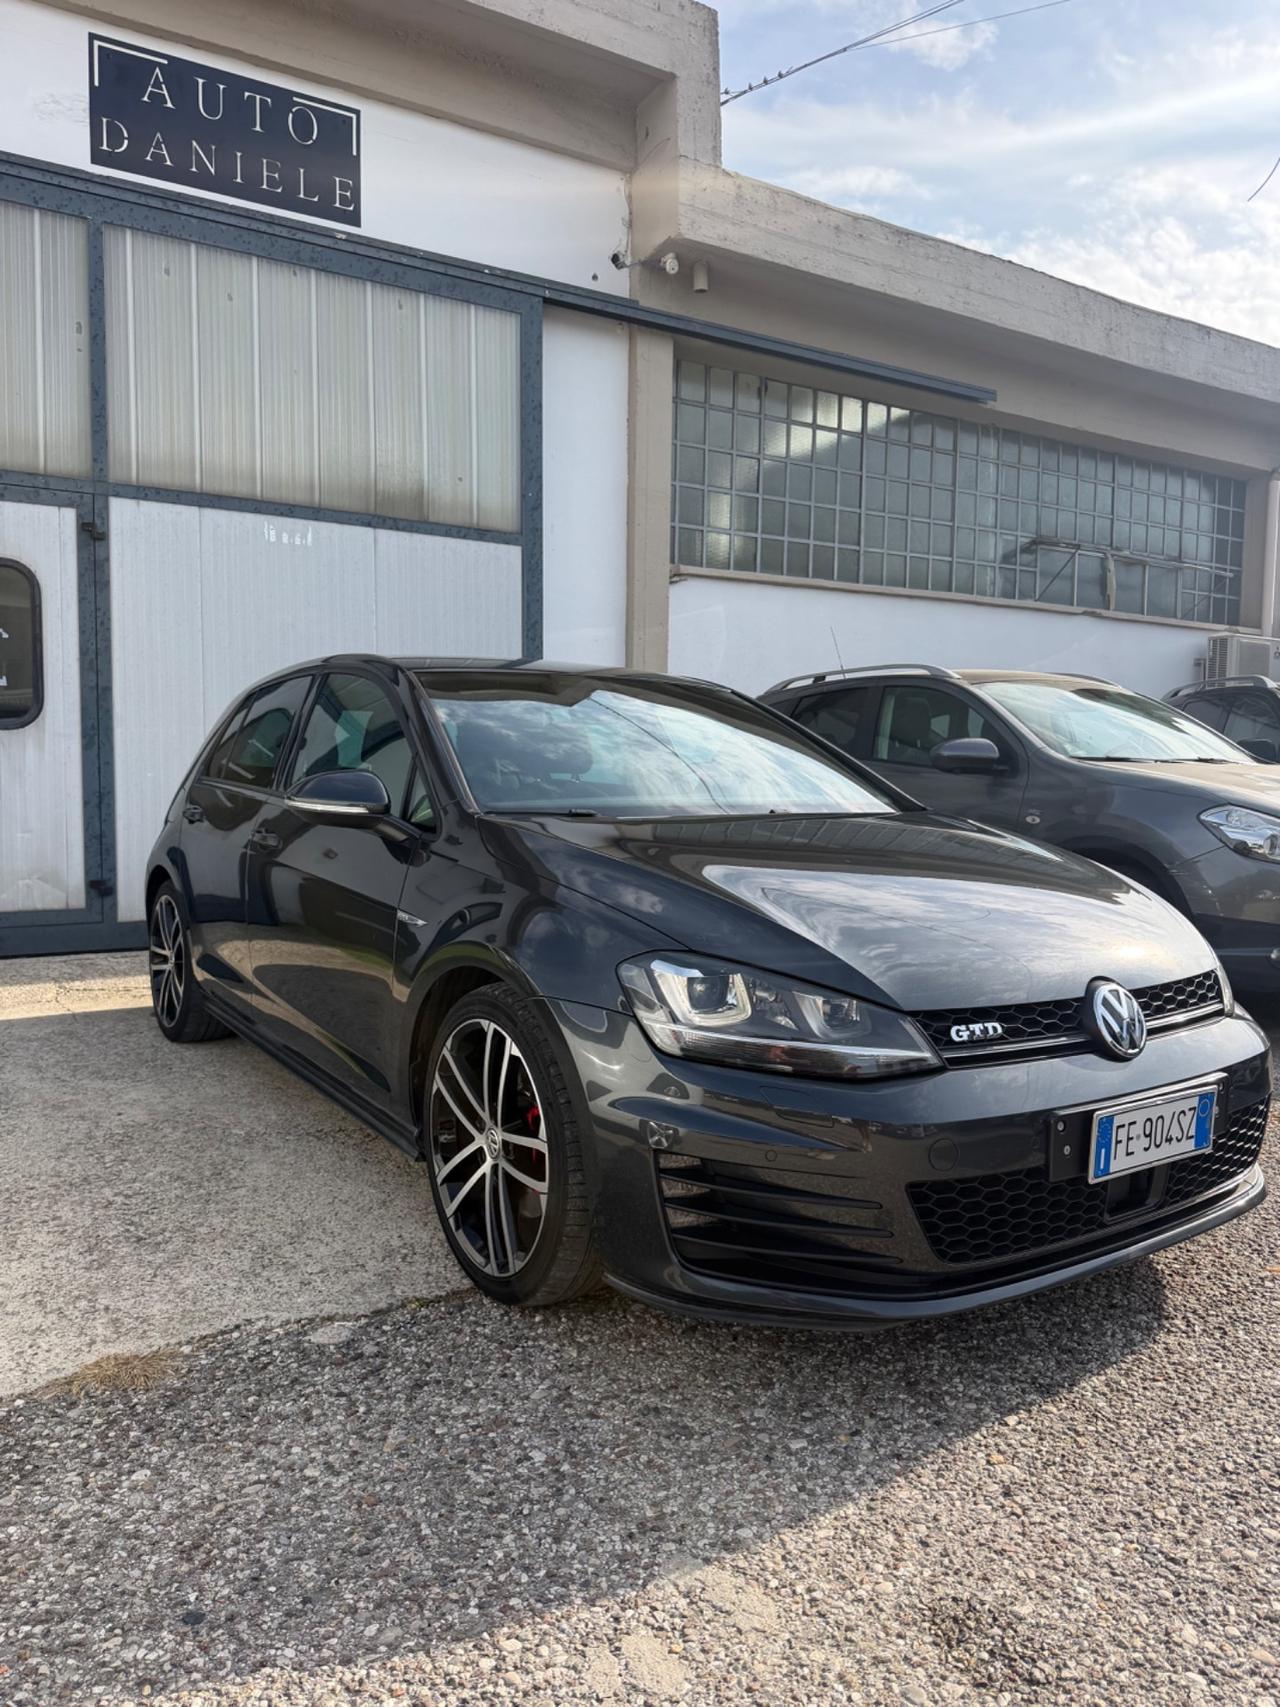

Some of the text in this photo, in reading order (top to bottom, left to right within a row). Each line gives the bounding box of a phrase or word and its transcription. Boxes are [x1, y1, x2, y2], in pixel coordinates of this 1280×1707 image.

[142, 66, 318, 145] AUTO
[99, 117, 355, 211] DANIELE
[950, 1021, 1003, 1043] GTD
